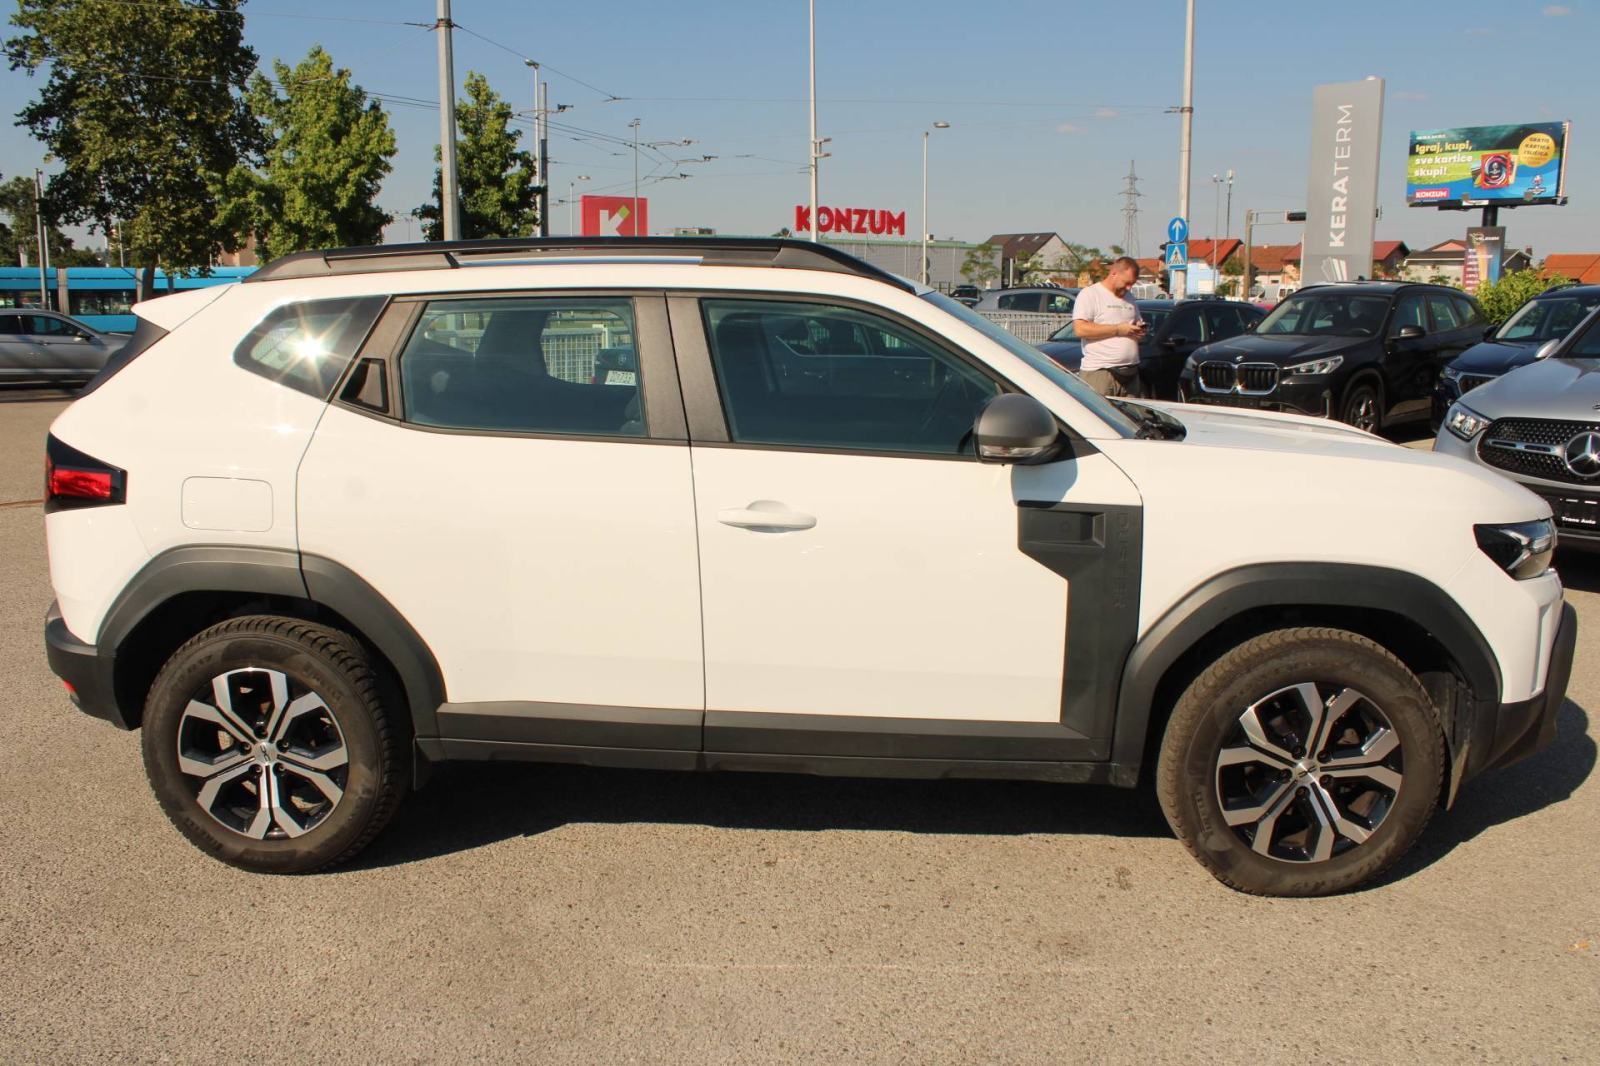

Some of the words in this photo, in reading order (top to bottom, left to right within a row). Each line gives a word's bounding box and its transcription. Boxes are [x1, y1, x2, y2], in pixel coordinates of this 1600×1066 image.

[1415, 143, 1443, 155] Igraj,
[1445, 140, 1473, 151] kupi,
[1415, 157, 1433, 165] sve
[1434, 154, 1473, 164] kartice
[1329, 104, 1353, 247] KERATERM
[1414, 168, 1447, 178] skupi!
[795, 205, 906, 236] KONZUM
